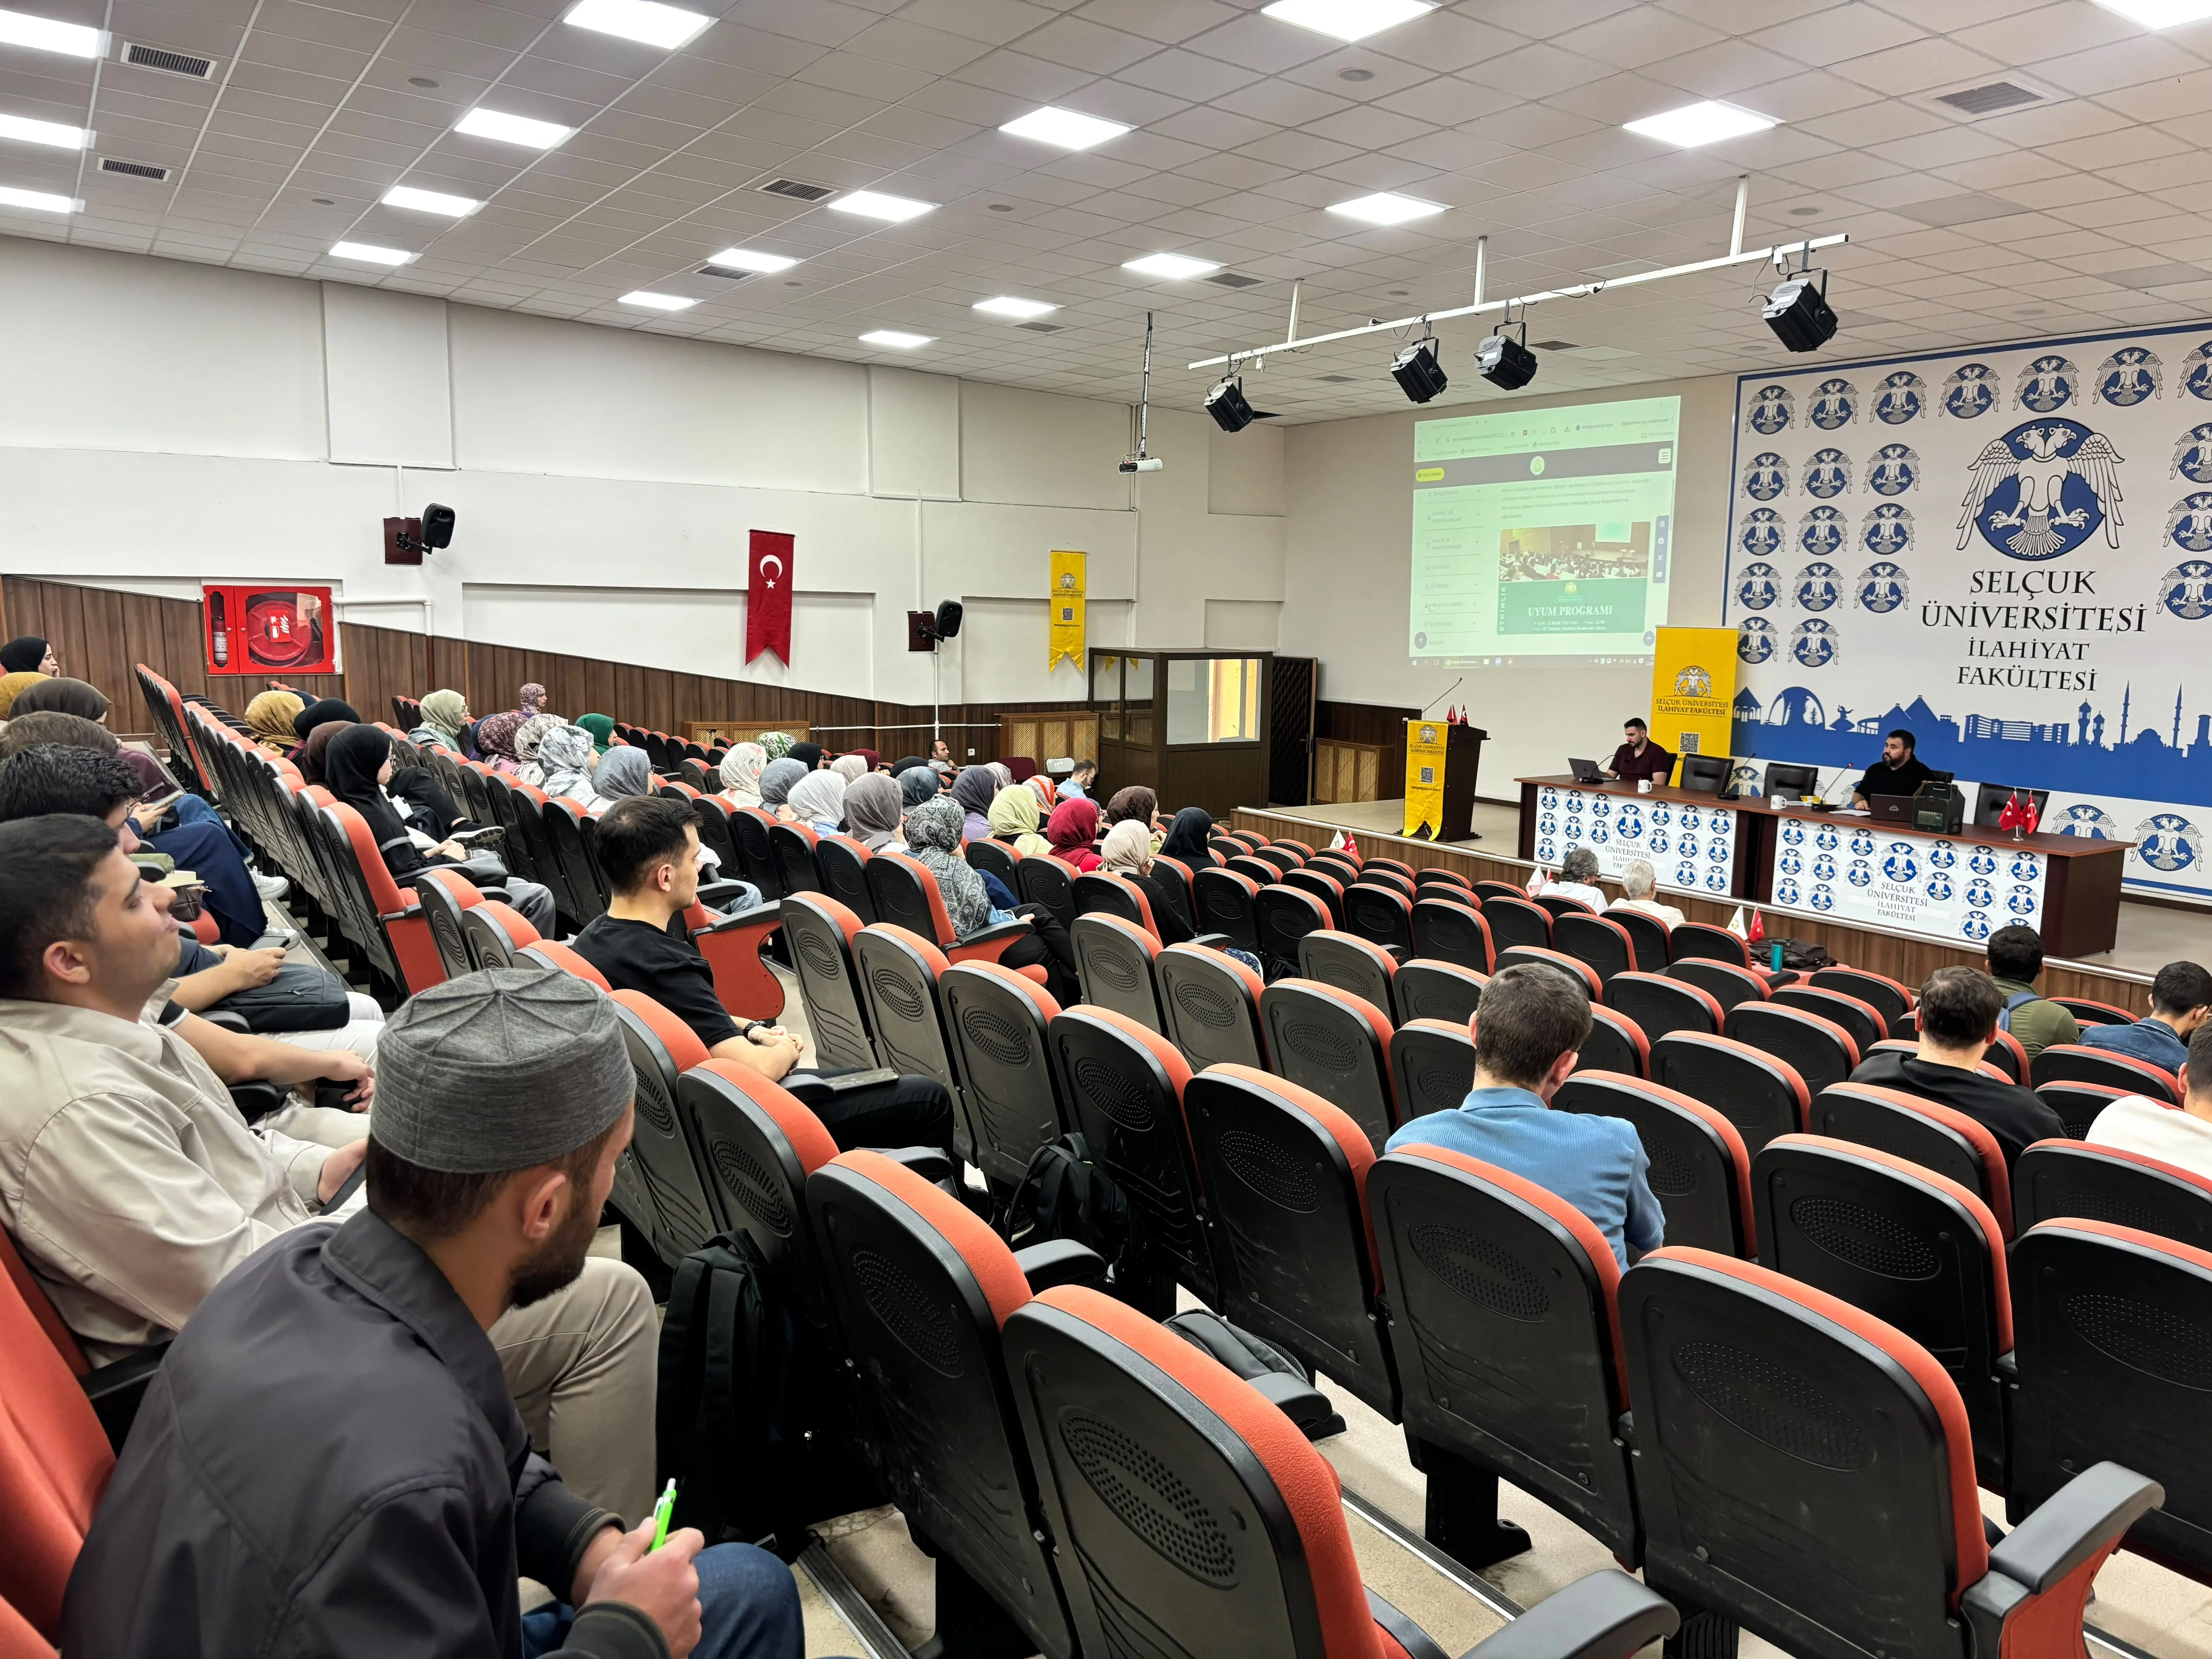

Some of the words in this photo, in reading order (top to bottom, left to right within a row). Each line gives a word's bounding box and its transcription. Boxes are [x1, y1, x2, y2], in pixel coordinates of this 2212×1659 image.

[1970, 569, 2097, 601] SELÇUK
[1528, 607, 1556, 616] UYUM
[1559, 605, 1613, 616] PROGRAMI
[1921, 600, 2148, 634] ÜNİVERSİTESİ
[1967, 637, 2090, 661] İLAHİYAT
[1956, 665, 2098, 692] FAKÜLTESİ
[1683, 699, 1728, 708] ÜNİVERSİTESİ
[1616, 839, 1641, 849] SELÇUK
[1605, 845, 1650, 859] ÜNİVERSİTESİ
[1881, 882, 1916, 894] SELÇUK
[1867, 888, 1928, 906] ÜNİVERSİTESİ
[1878, 900, 1916, 913] İLAHİYAT
[1877, 909, 1915, 921] FAKÜLTESİ
